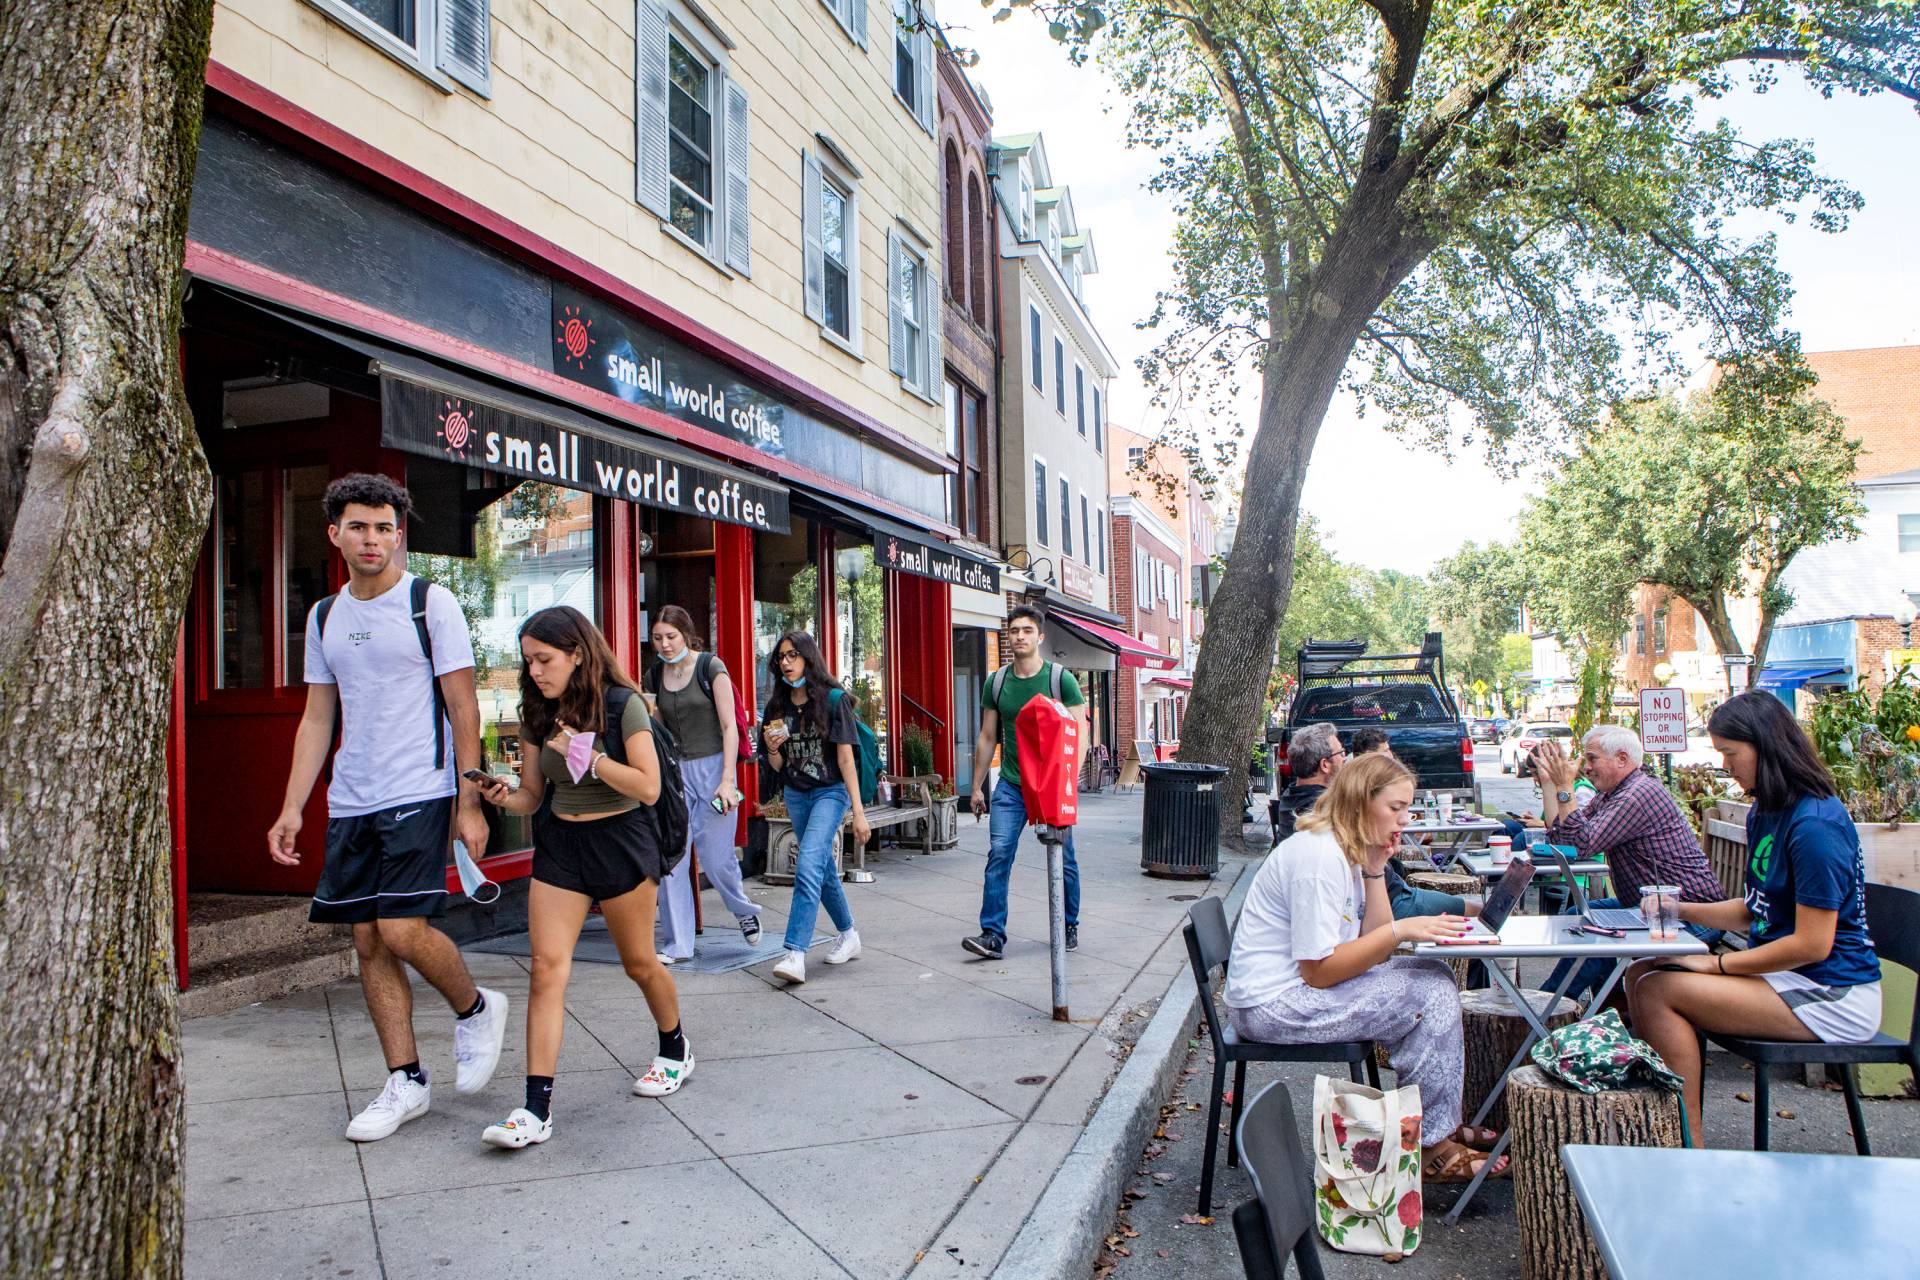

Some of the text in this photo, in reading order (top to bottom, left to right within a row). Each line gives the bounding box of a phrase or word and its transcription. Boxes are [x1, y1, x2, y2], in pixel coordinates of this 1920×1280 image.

[607, 354, 662, 397] small
[669, 381, 725, 423] world
[485, 431, 578, 482] small
[596, 459, 679, 506] world
[900, 546, 929, 574] small
[932, 556, 960, 582] world
[348, 631, 371, 641] NIKE
[1653, 697, 1671, 710] NO
[1643, 712, 1683, 722] STOPPING
[1657, 724, 1670, 733] OR
[1645, 735, 1683, 744] STANDING
